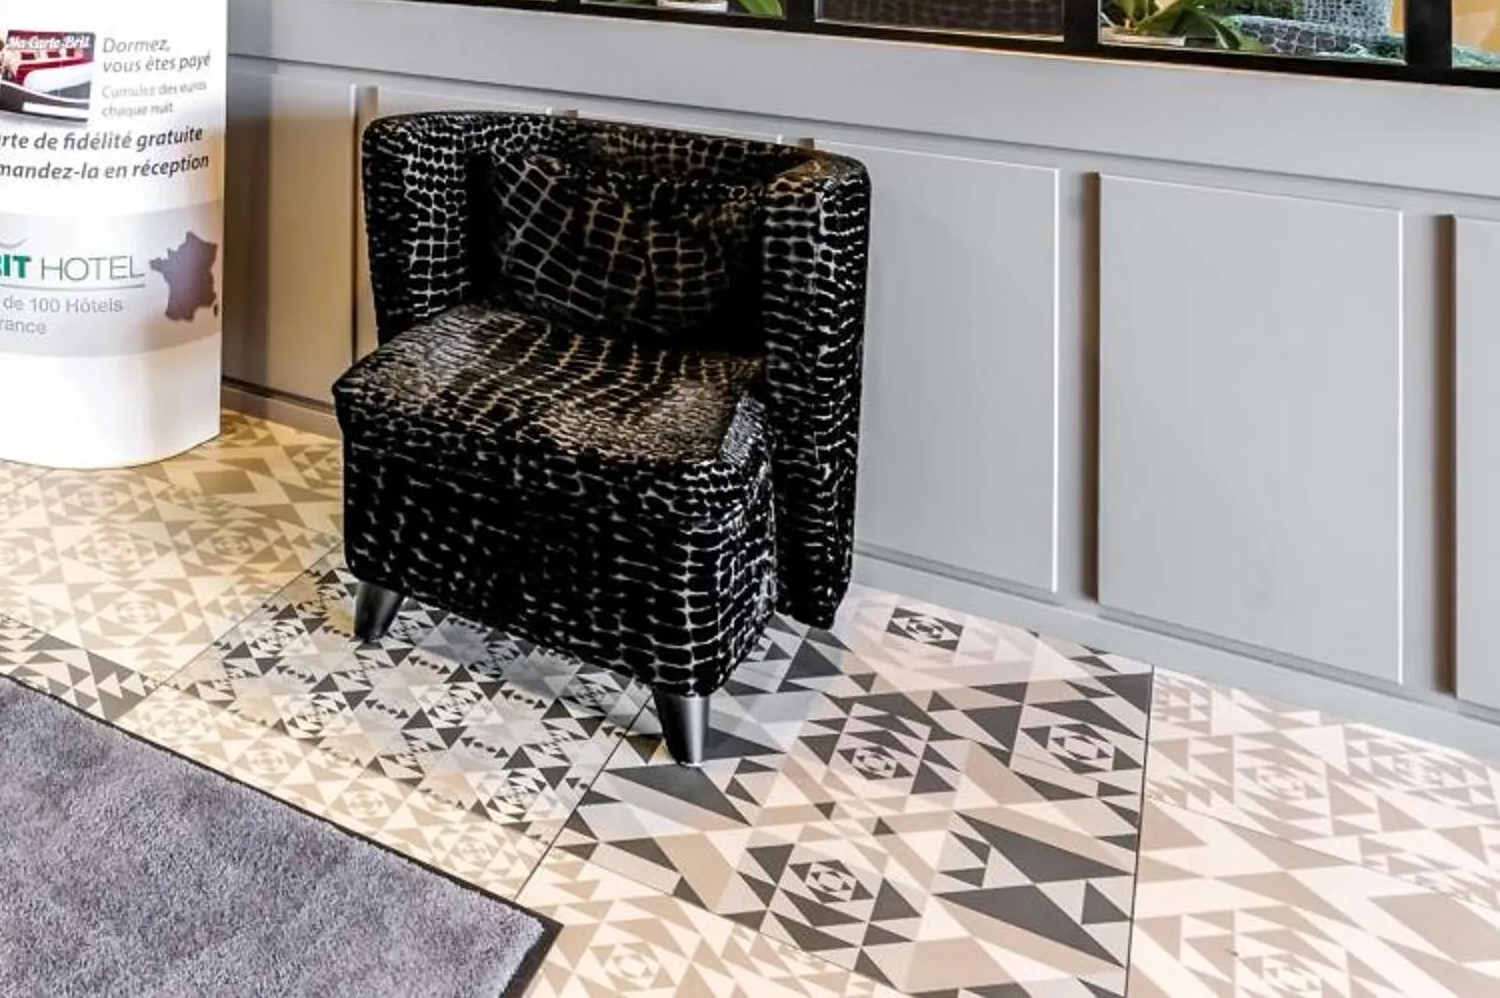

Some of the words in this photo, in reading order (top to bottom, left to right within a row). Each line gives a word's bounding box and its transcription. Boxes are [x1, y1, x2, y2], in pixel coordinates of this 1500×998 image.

[102, 36, 171, 54] Dormez,
[102, 57, 142, 73] vous
[145, 54, 176, 72] êtes
[179, 50, 212, 73] payé
[158, 83, 178, 96] des
[101, 104, 148, 119] chaque
[34, 132, 58, 151] de
[63, 129, 132, 151] fidélité
[137, 126, 203, 153] gratuite
[105, 163, 127, 180] en
[132, 154, 209, 179] réception
[40, 255, 146, 283] HOTEL
[3, 293, 26, 311] de
[30, 296, 60, 314] 100
